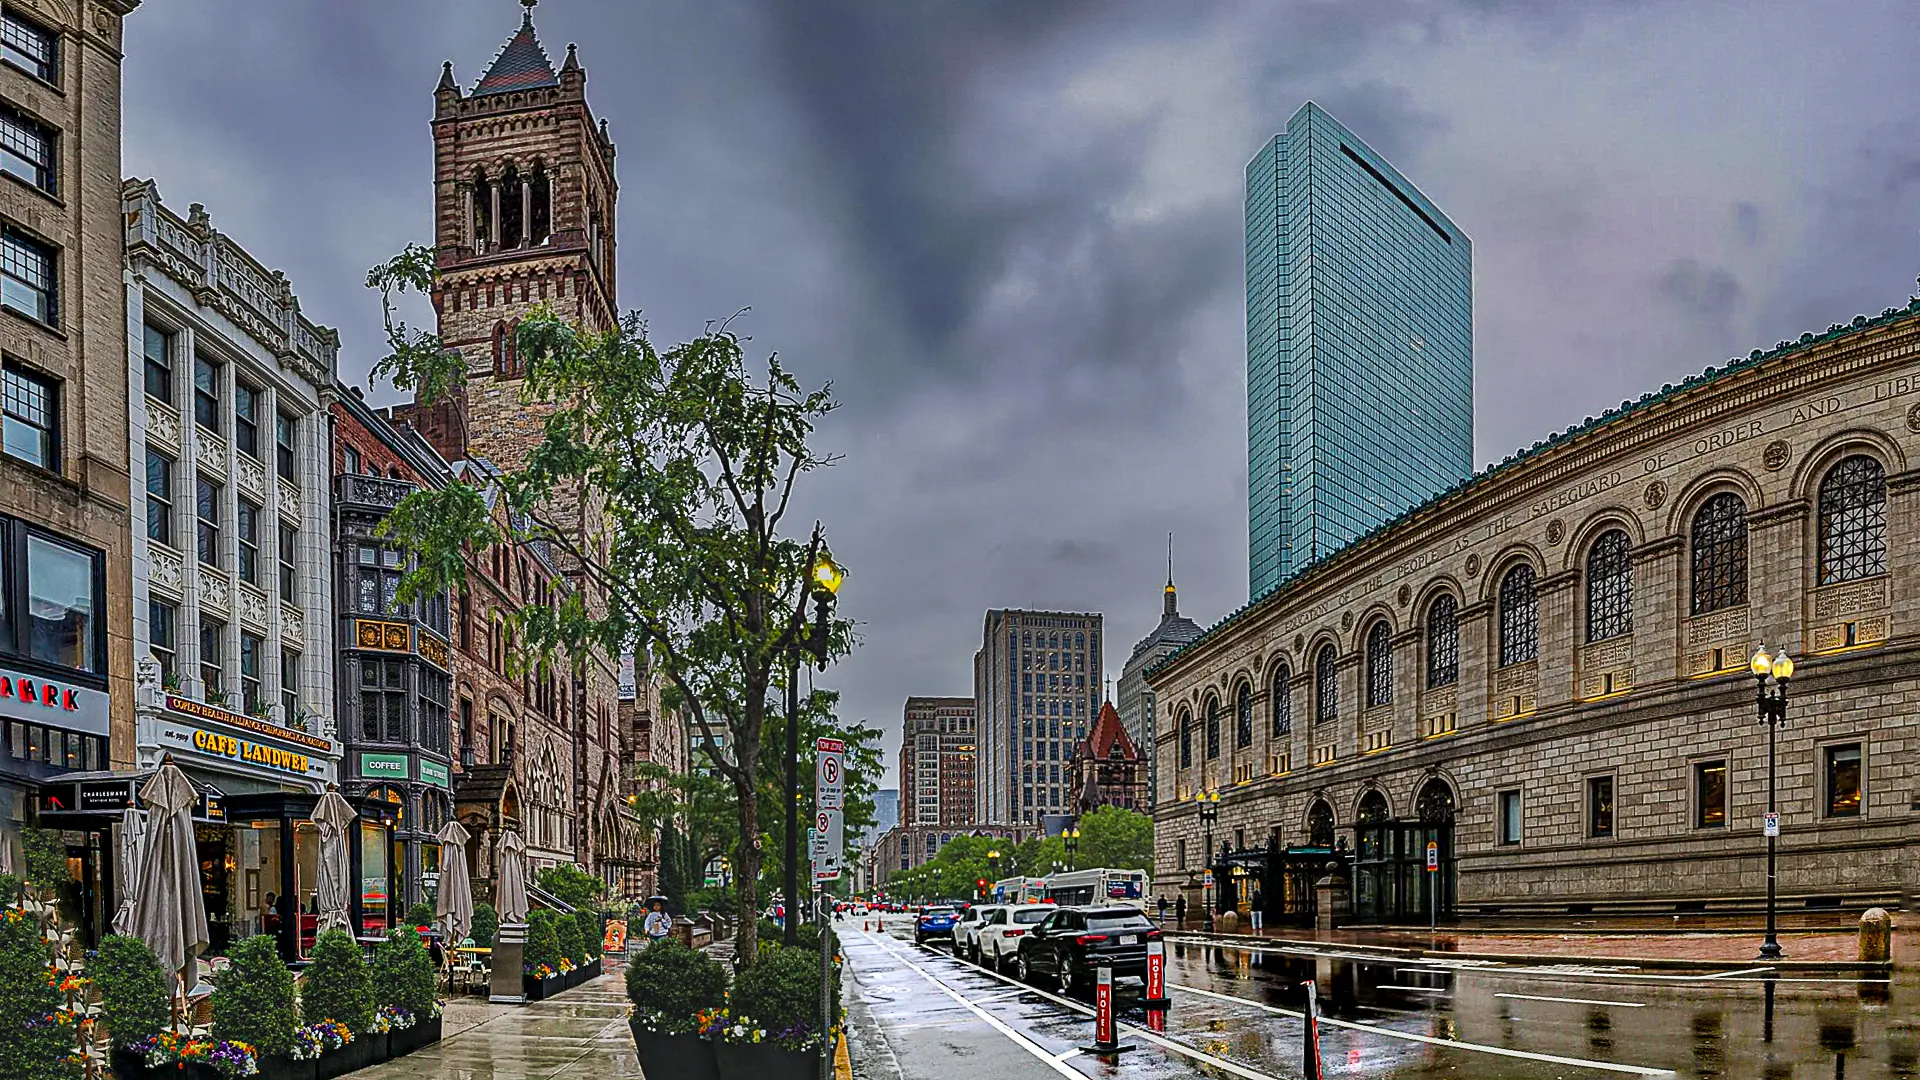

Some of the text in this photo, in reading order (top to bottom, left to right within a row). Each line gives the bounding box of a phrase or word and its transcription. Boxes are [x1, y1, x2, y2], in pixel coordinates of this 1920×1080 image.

[1362, 575, 1383, 593] THE
[1398, 550, 1440, 578] PEOPLE
[1453, 536, 1470, 551] AS
[1485, 516, 1514, 537] THE
[1531, 472, 1621, 518] SAFEGUARD
[1644, 452, 1669, 472] OF
[1695, 420, 1764, 454] ORDER
[1792, 397, 1841, 424] AND
[173, 699, 201, 714] COPLEY
[202, 706, 230, 722] HEALTH
[194, 729, 238, 757] CAFE
[241, 741, 309, 773] LANDWER
[369, 761, 401, 770] COFFEE
[83, 790, 127, 798] CHARLESMARK
